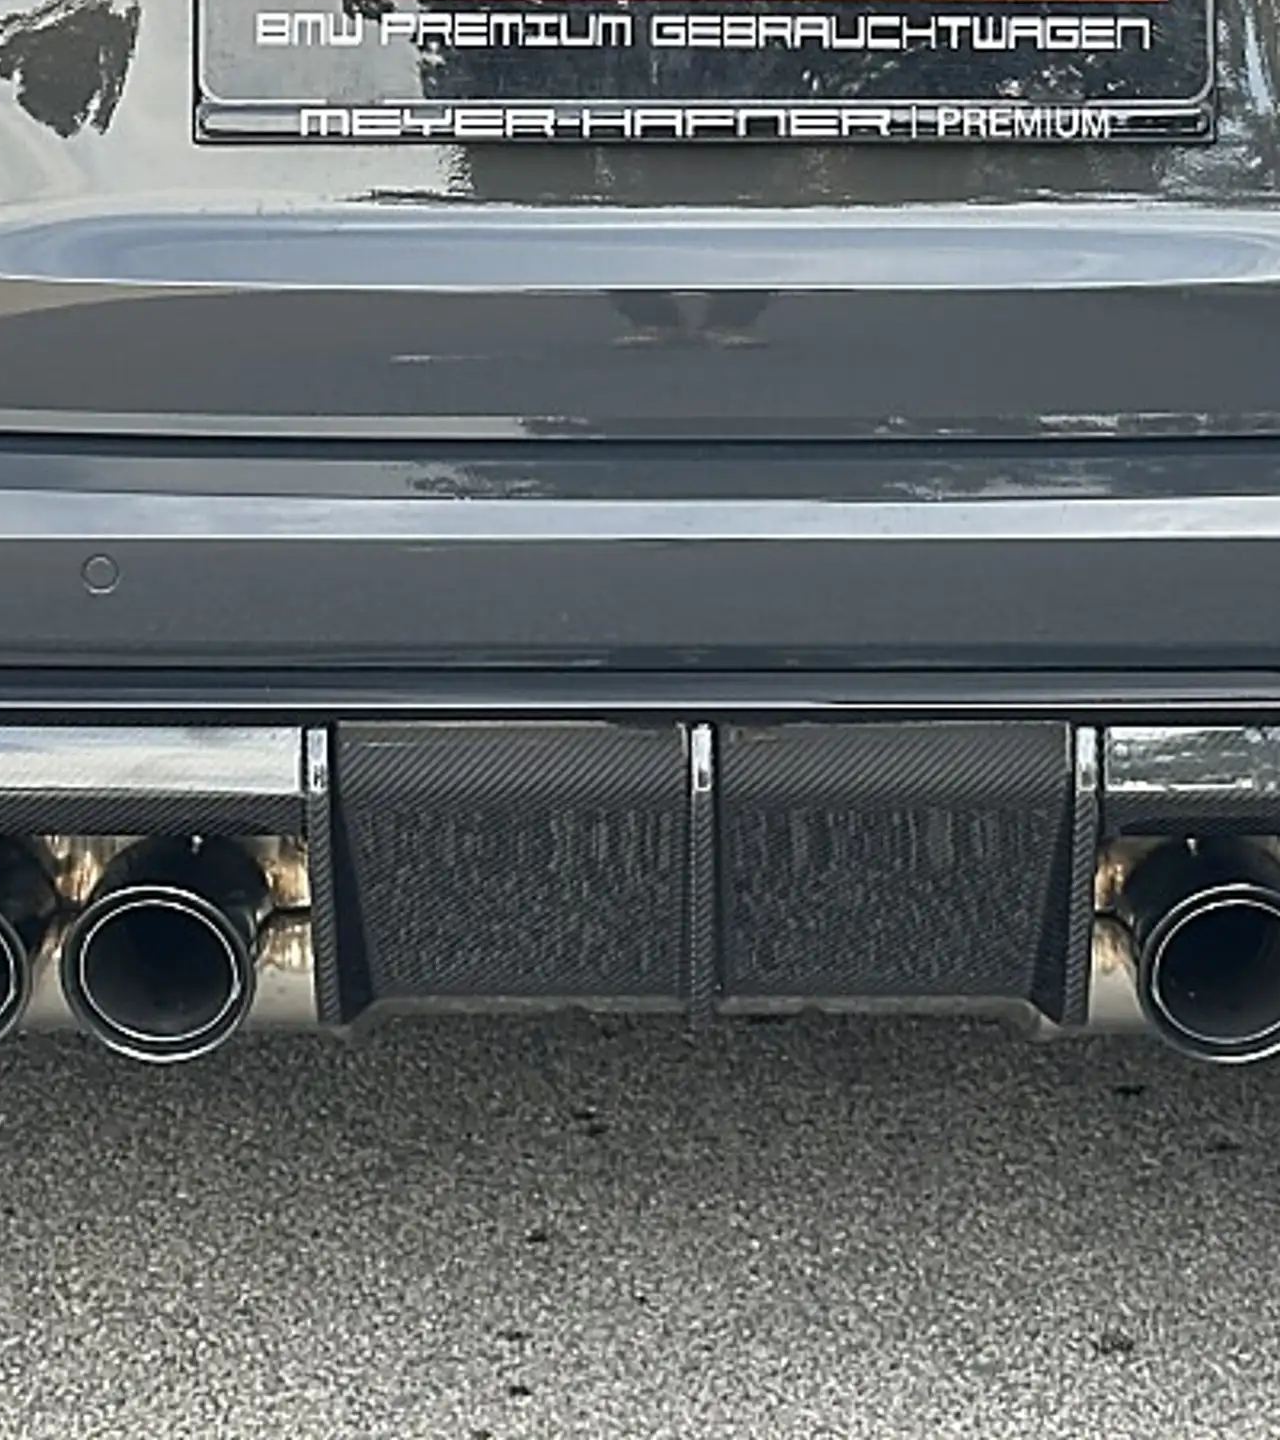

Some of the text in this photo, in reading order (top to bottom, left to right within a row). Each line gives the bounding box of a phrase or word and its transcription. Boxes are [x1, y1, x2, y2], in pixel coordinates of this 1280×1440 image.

[254, 12, 1151, 50] BMW PREMIUM GEBRAUCHTWAGEN
[299, 107, 1112, 139] MEYER-HAFNER PREMIUM
